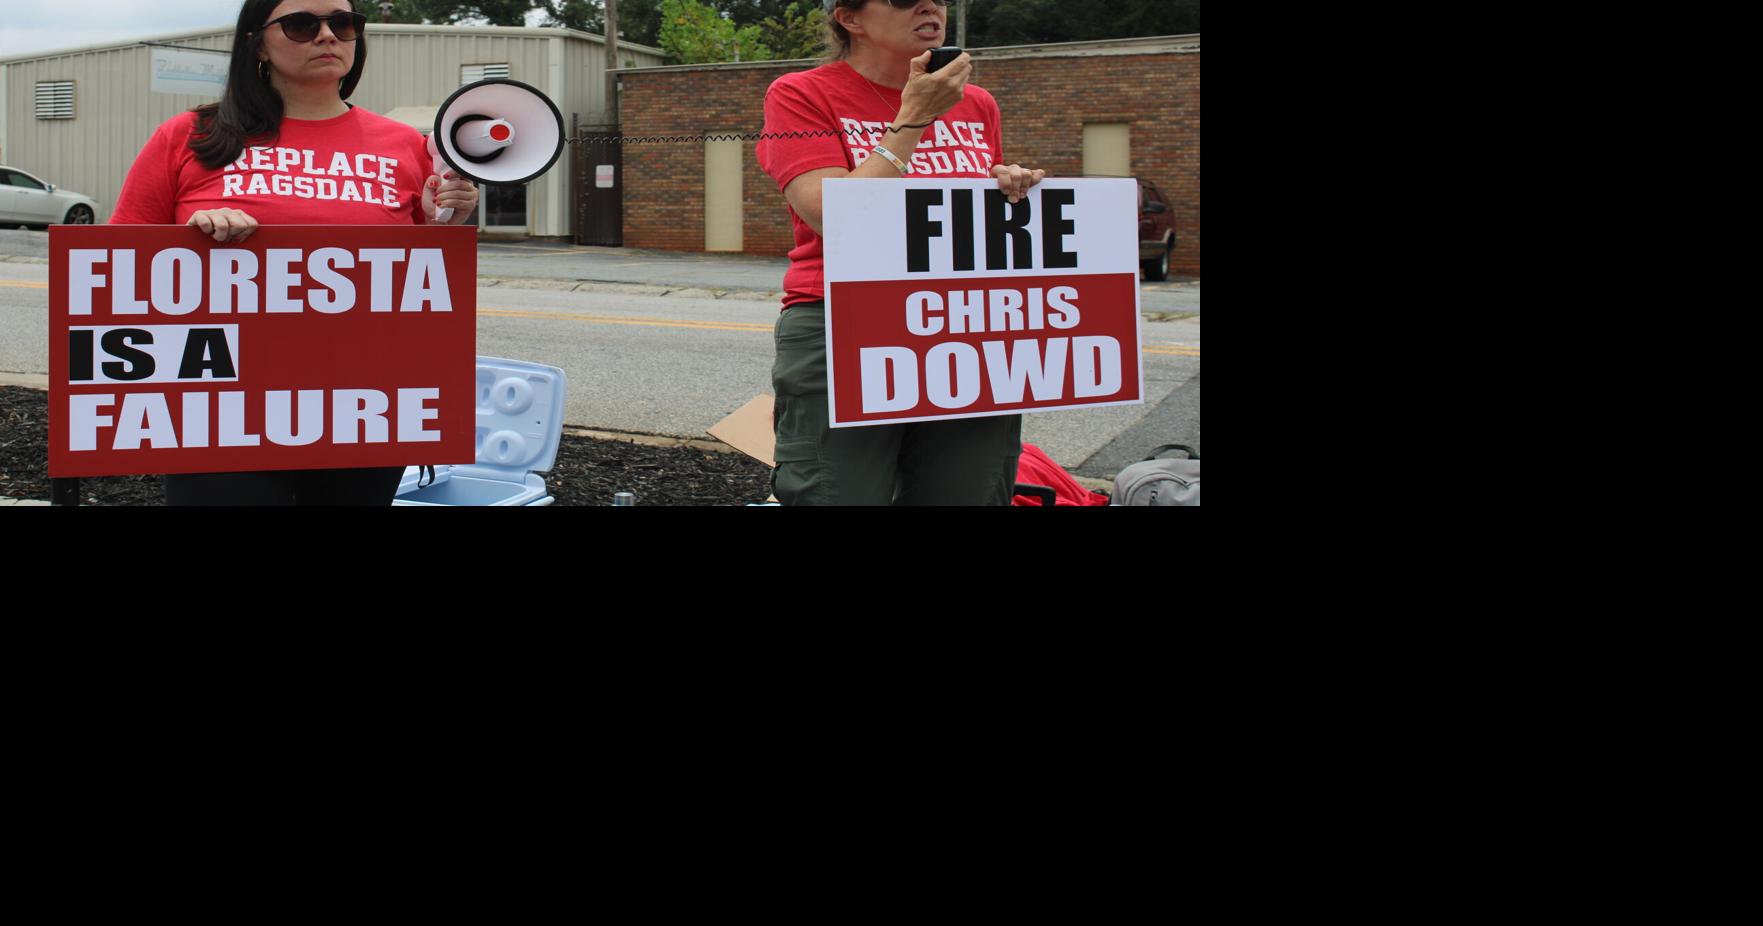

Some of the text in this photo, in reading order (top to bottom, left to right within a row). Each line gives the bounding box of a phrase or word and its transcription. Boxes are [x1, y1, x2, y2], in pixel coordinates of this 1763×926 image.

[840, 117, 990, 149] REACE
[222, 173, 401, 208] RAGSDALE
[905, 188, 1078, 272] FIRE
[69, 247, 452, 315] FLORESTA
[906, 286, 1080, 336] CHRIS
[69, 328, 236, 381] IS A
[860, 335, 1122, 414] DOWD
[69, 387, 441, 451] FAILURE
